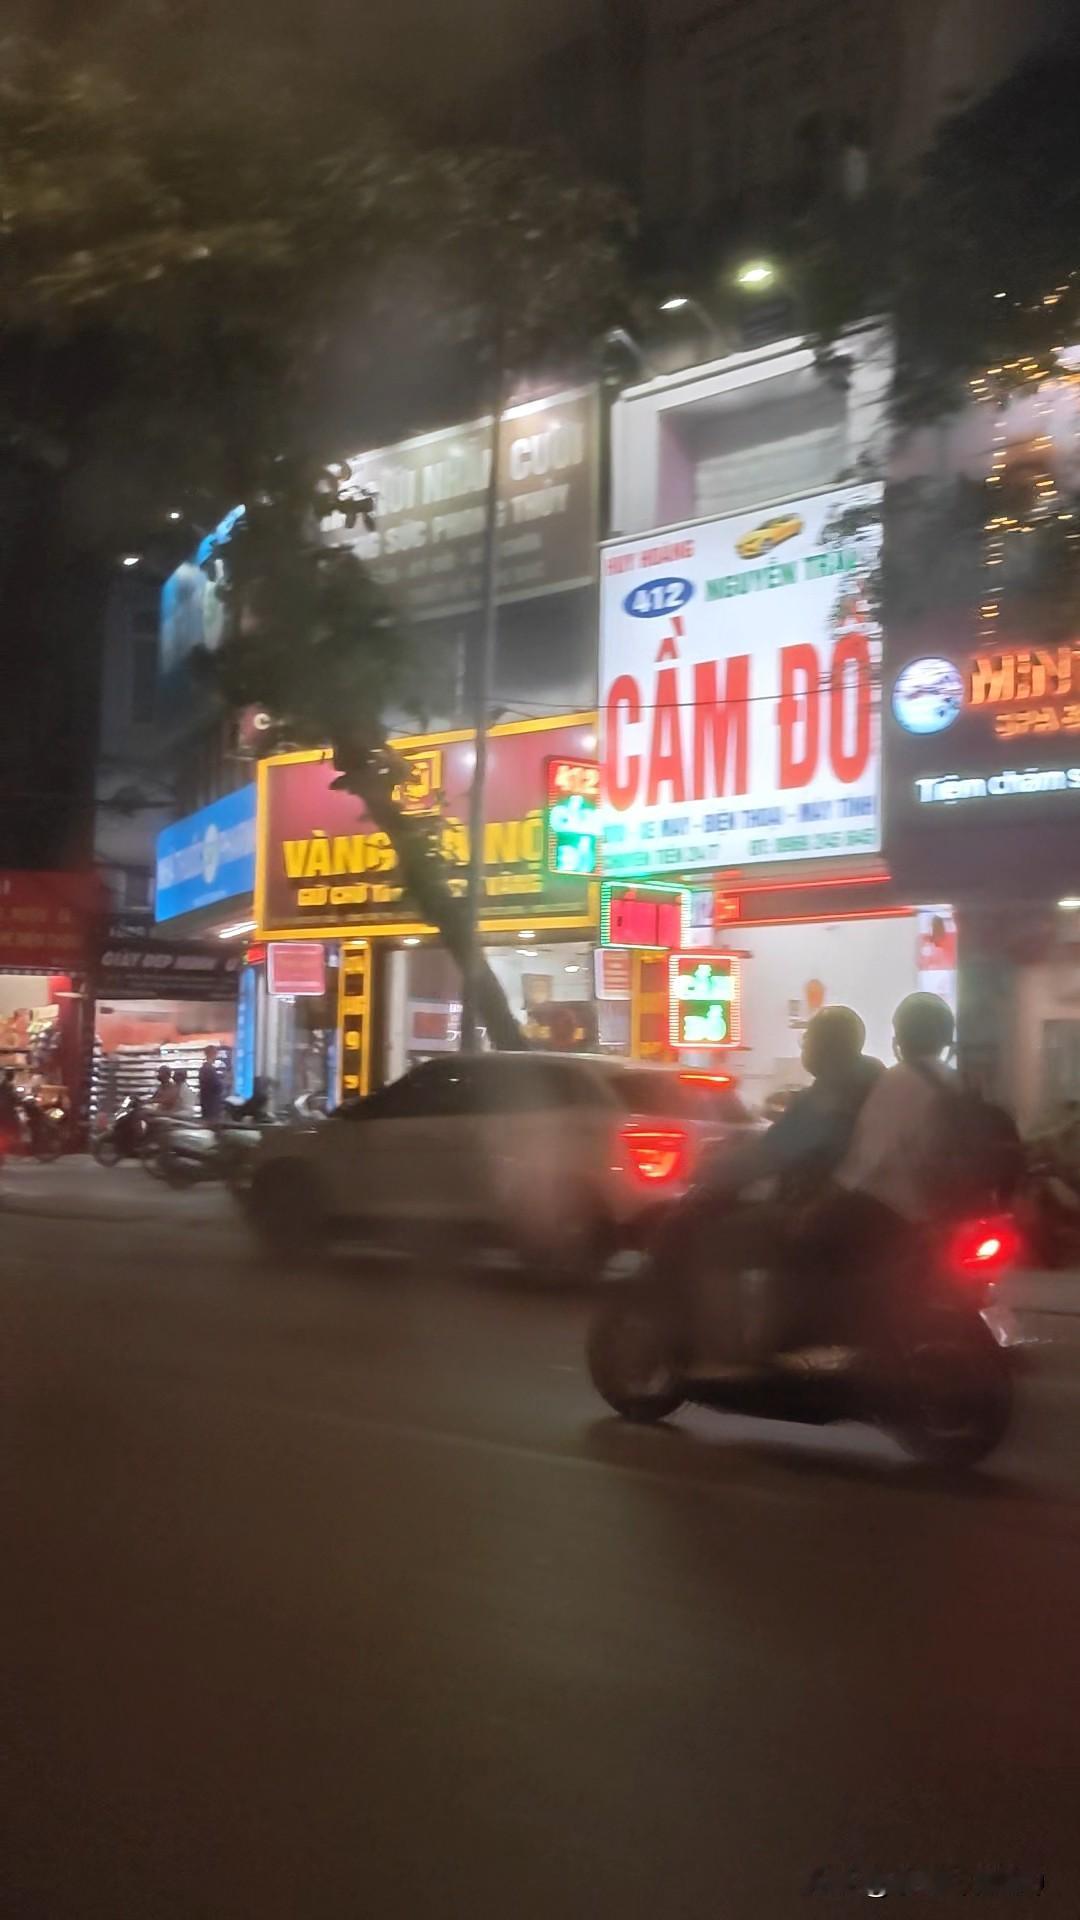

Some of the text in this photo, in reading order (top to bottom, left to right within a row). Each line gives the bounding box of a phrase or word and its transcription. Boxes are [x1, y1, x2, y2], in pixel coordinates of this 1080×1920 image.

[631, 582, 684, 613] 412
[605, 615, 753, 812] CẦM
[554, 764, 601, 795] 412
[282, 828, 398, 879] VÀNG
